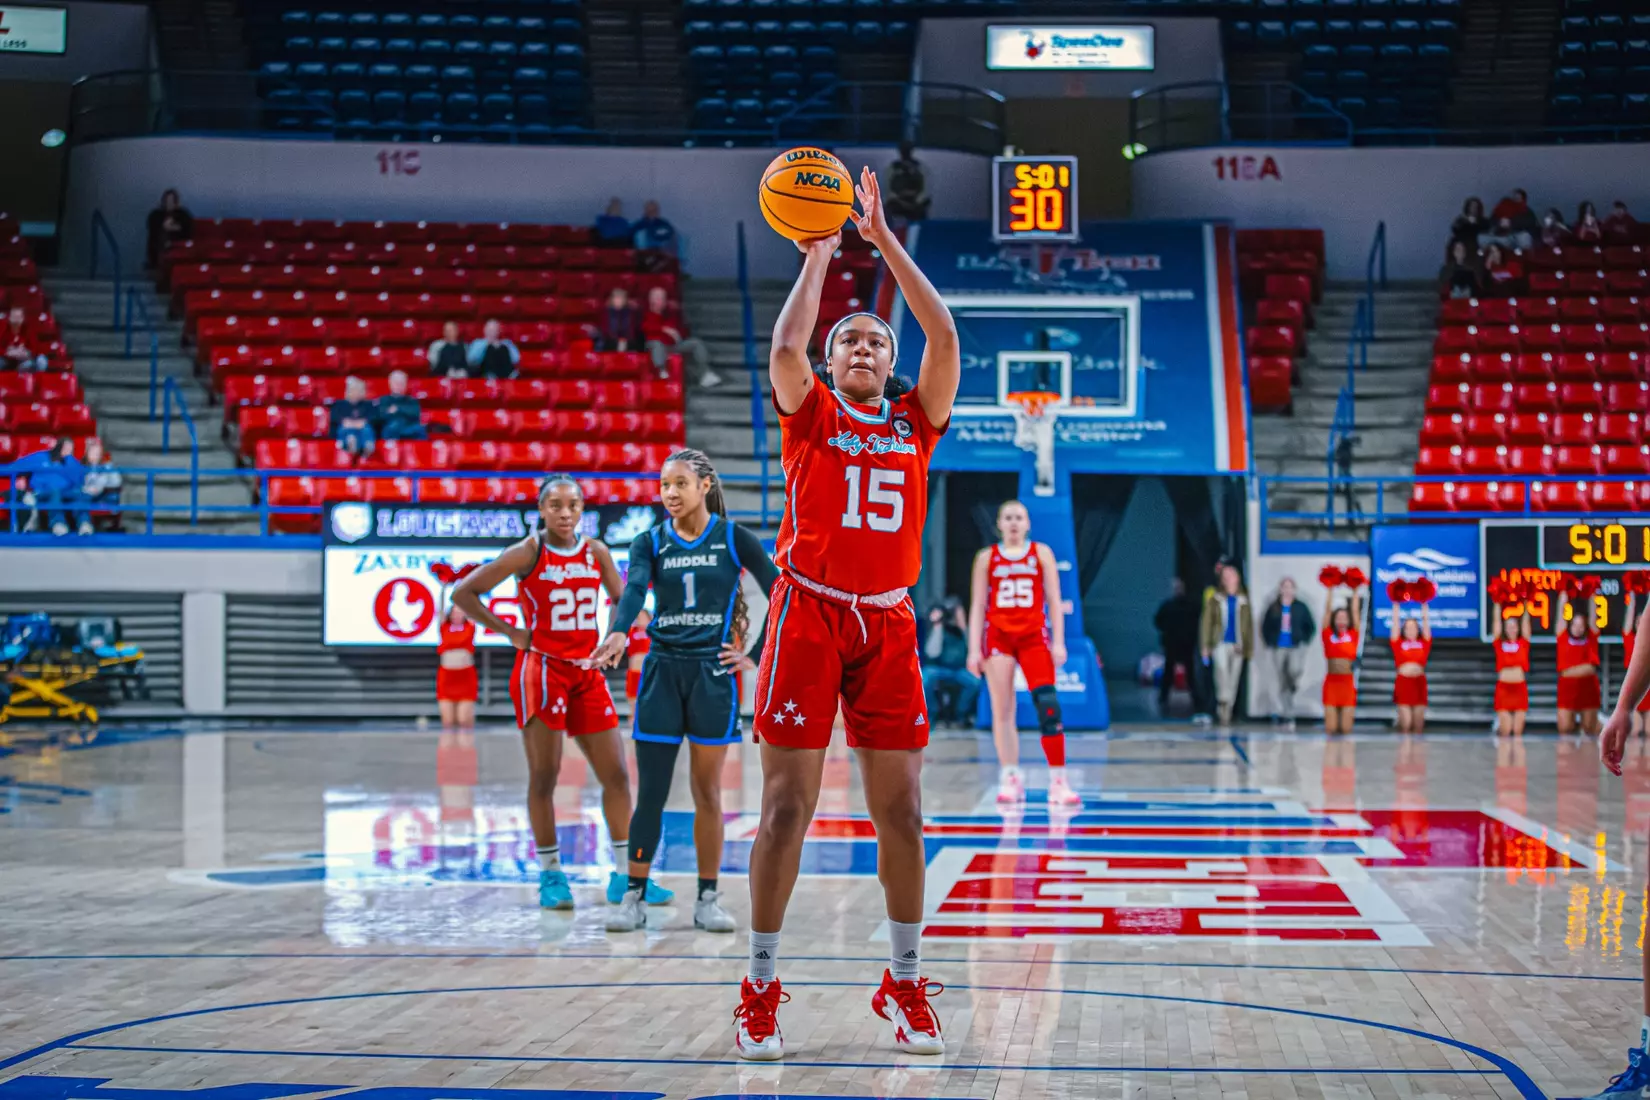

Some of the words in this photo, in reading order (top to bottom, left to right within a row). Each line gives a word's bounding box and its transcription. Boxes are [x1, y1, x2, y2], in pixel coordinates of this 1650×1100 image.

[794, 171, 840, 192] NCAA
[1015, 164, 1069, 189] 5:01
[1010, 189, 1062, 231] 30
[842, 466, 905, 532] 15
[524, 511, 600, 538] TH
[663, 554, 717, 569] MIDDLE
[682, 572, 695, 608] 1
[996, 578, 1034, 608] 25
[549, 587, 597, 631] 22
